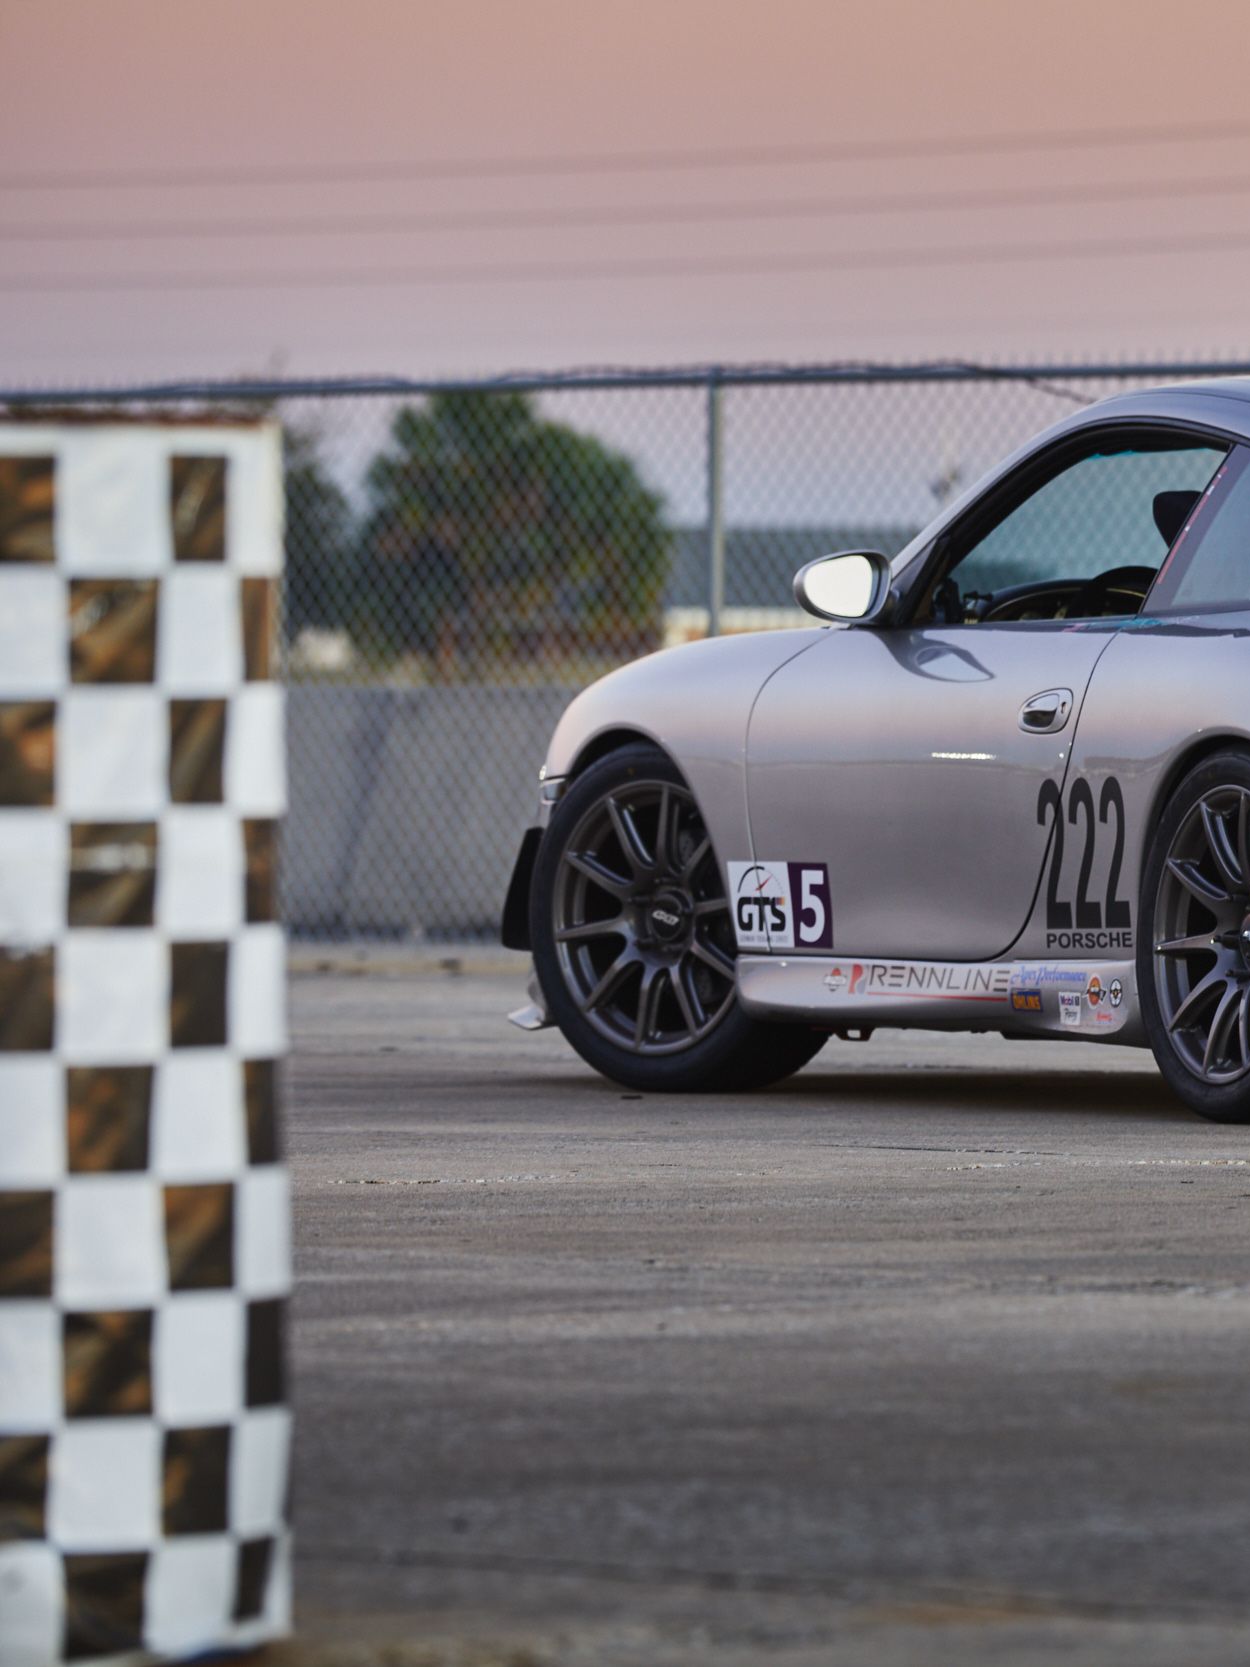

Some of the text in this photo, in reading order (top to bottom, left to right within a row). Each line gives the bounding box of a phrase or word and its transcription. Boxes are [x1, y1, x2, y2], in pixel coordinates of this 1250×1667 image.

[1037, 776, 1131, 929] 222
[737, 869, 826, 943] GTS 5
[1046, 931, 1133, 949] PORSCHE
[869, 964, 1010, 993] RENNLINE
